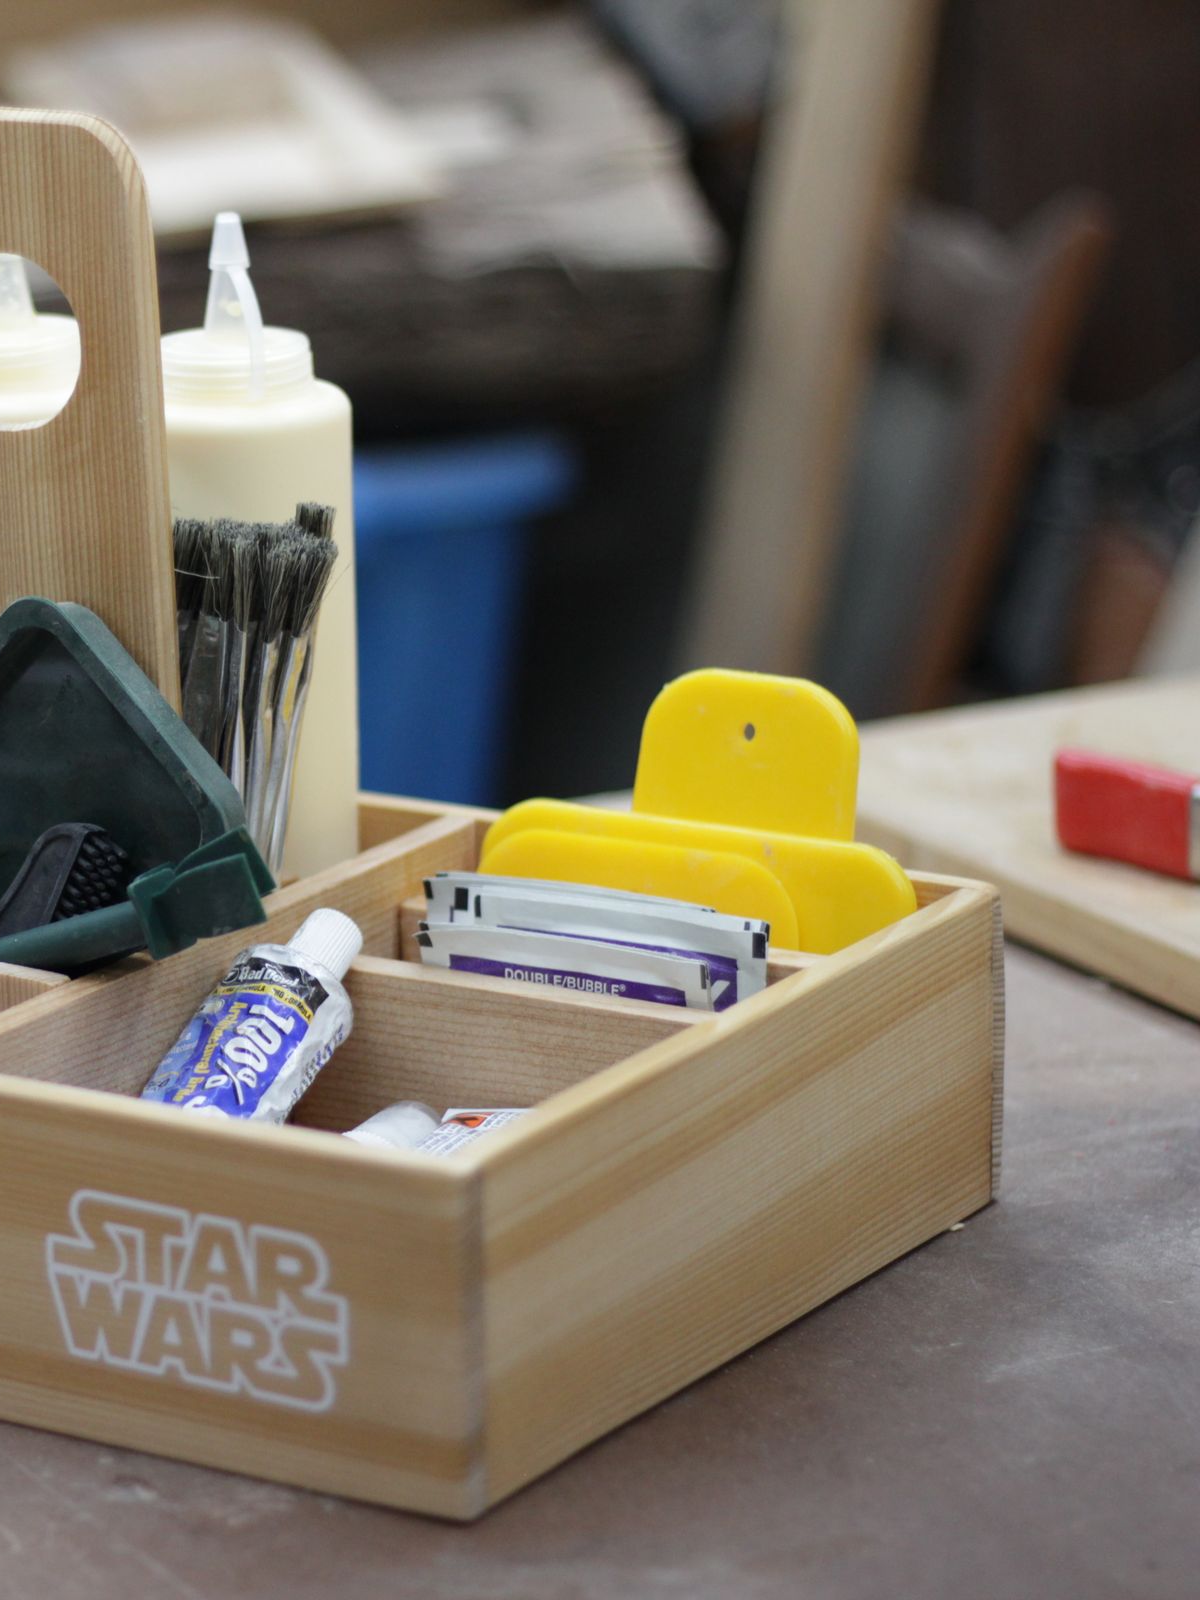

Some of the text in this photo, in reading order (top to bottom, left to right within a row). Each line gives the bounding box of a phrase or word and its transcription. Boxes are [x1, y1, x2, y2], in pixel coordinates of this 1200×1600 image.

[204, 1004, 295, 1106] 100%
[46, 1189, 349, 1332] STAR
[49, 1268, 349, 1412] WARS
